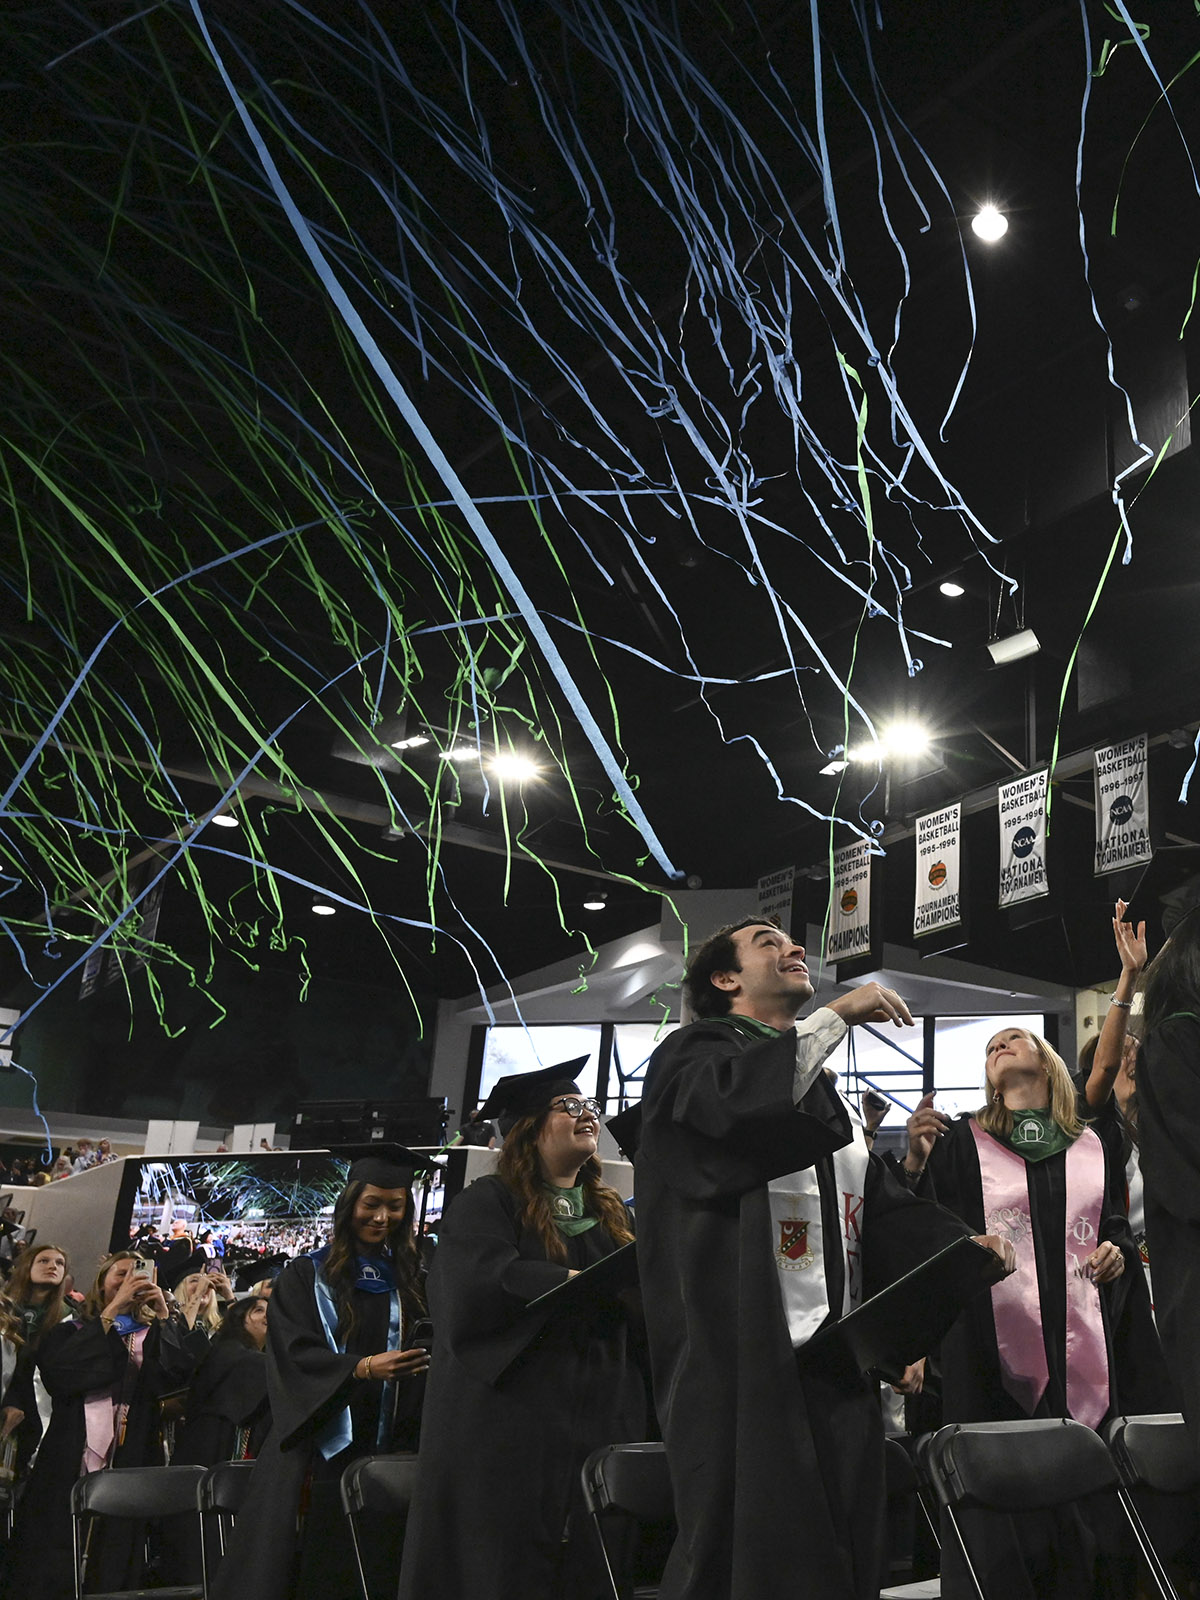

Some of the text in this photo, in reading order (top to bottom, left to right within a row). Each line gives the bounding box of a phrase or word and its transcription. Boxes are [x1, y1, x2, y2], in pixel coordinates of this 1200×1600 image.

[1097, 737, 1146, 763] WOMEN'S
[1097, 751, 1147, 777] BASKETBALL
[1002, 775, 1045, 799] WOMEN'S
[1100, 771, 1144, 795] 1996-1997
[1001, 788, 1046, 813] BASKETBALL
[1110, 804, 1133, 816] NCAA
[919, 808, 959, 831] WOMEN'S
[918, 821, 959, 845] BASKETBALL
[1013, 836, 1035, 850] NCAA
[915, 904, 960, 930] CHAMPIONS
[828, 925, 869, 954] CHAMPIONS
